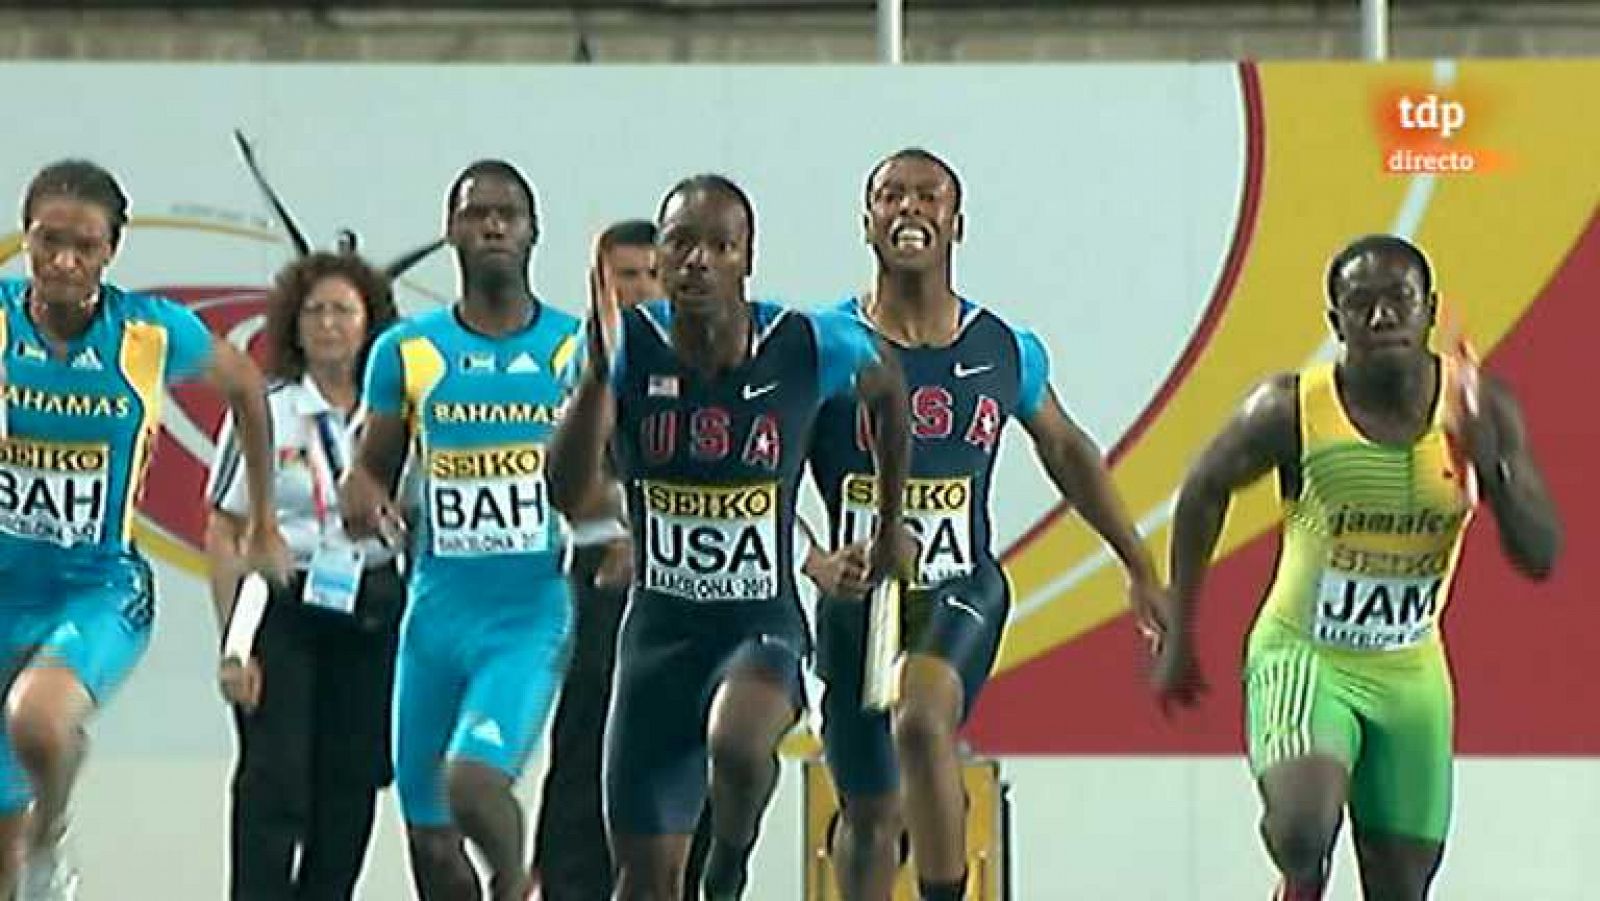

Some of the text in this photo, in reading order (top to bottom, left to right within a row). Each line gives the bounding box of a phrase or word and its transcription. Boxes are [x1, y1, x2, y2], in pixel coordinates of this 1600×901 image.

[640, 407, 782, 470] USA
[432, 449, 540, 478] SEIKO
[435, 482, 544, 531] BAH
[649, 485, 770, 520] SEIKO
[847, 477, 966, 510] SIKO
[650, 516, 771, 574] USA
[1323, 578, 1442, 625] JAM
